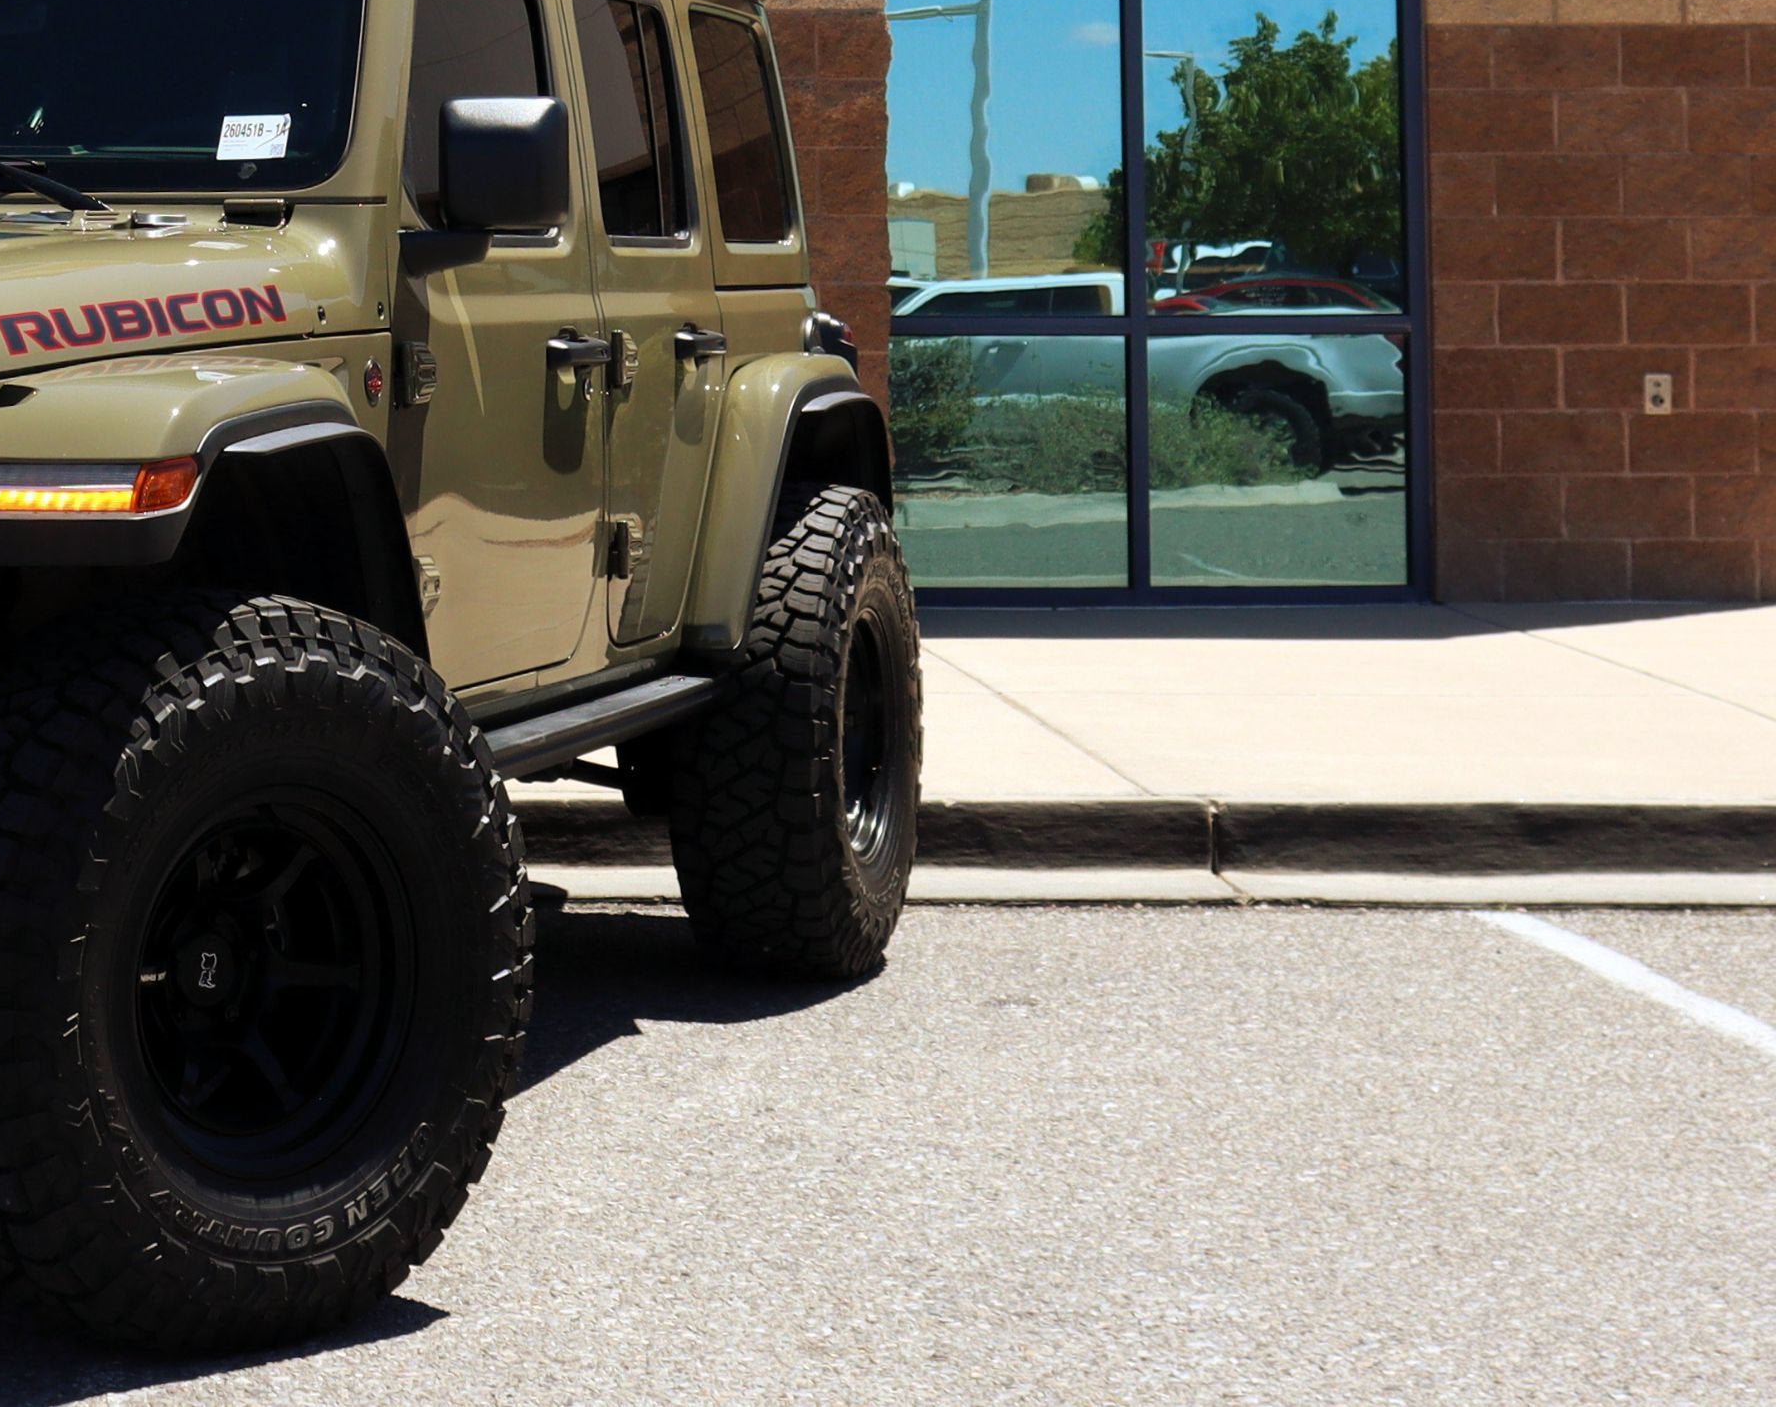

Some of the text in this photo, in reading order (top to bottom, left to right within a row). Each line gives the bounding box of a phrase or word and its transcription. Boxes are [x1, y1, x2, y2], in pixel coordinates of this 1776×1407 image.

[224, 123, 264, 138] 260451B
[344, 1121, 434, 1225] OPEN
[149, 1189, 336, 1251] COUNTRY
